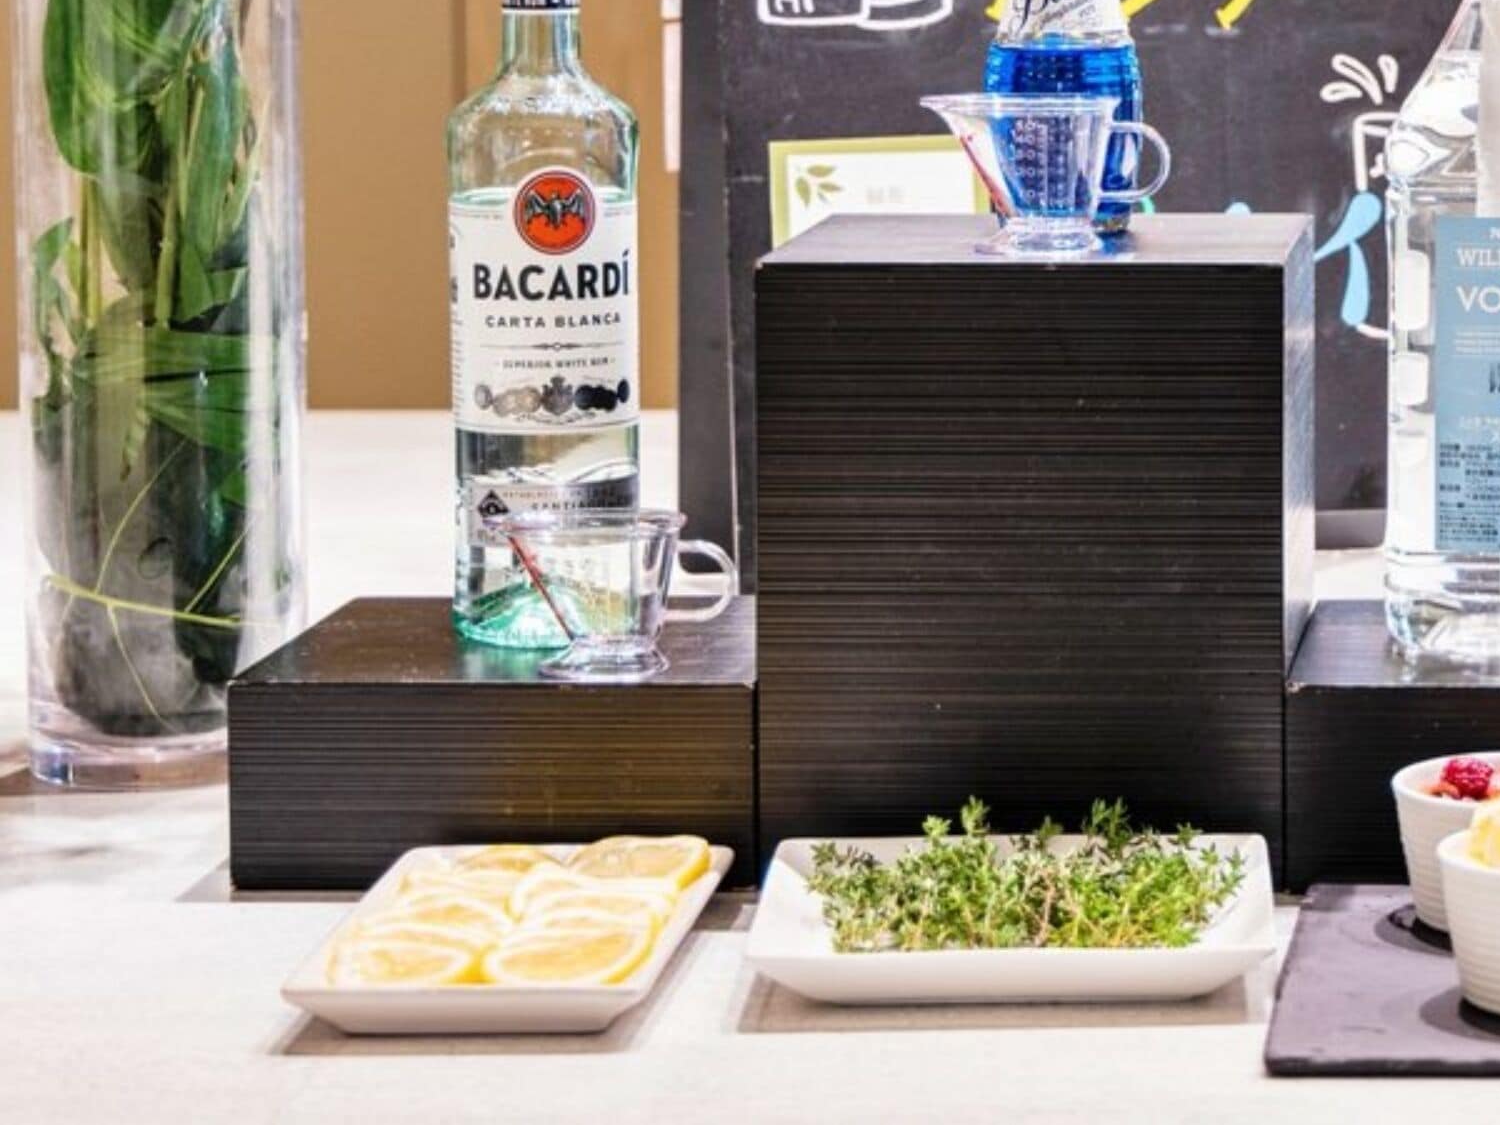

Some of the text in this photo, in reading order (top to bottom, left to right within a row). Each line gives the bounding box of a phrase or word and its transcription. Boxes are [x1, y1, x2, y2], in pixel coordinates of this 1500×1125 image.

[474, 249, 629, 301] BACARDÍ
[485, 312, 620, 328] CARTA BLANCA
